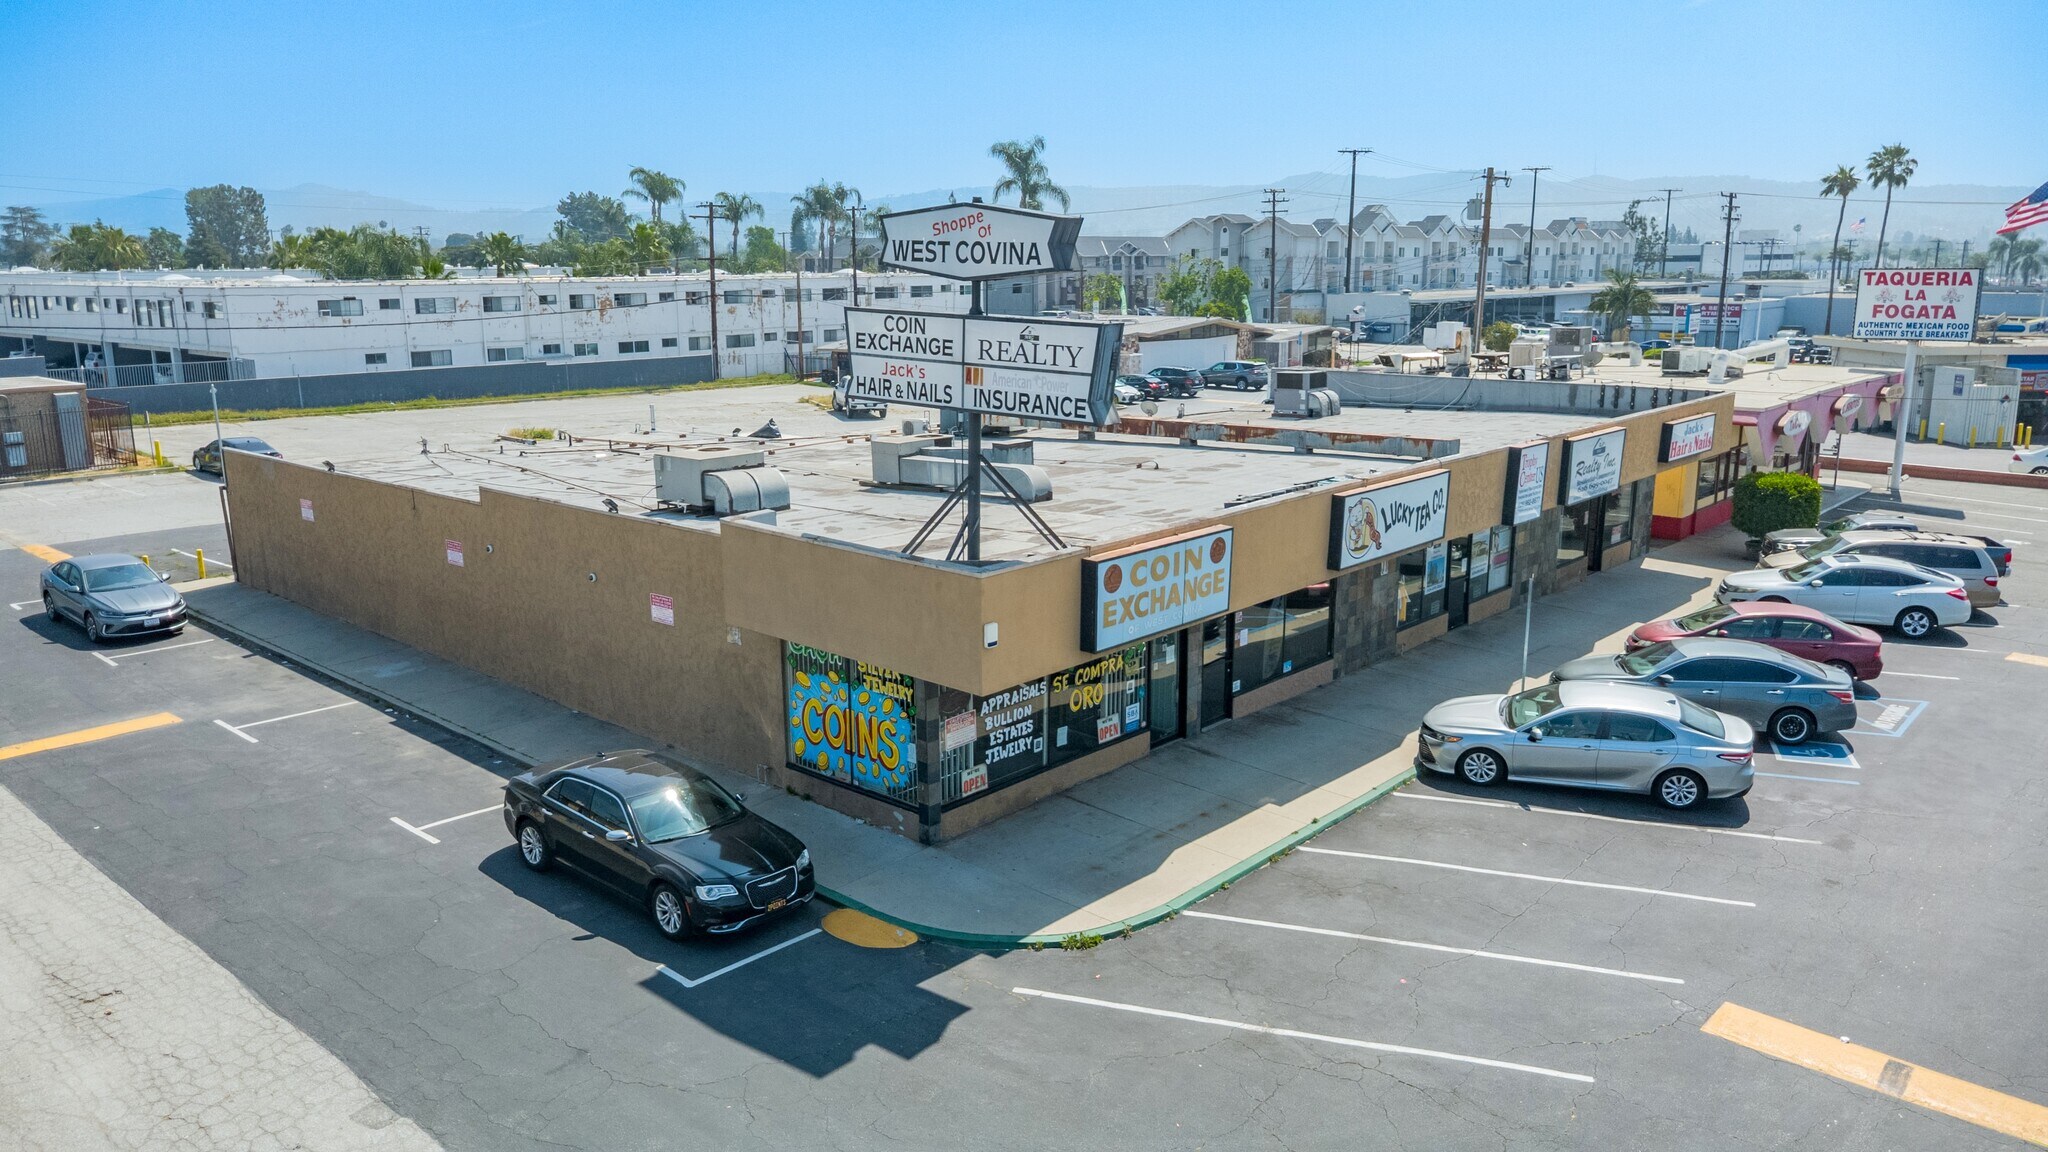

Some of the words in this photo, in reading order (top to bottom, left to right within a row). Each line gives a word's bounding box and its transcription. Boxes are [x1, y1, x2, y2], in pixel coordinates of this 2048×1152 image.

[932, 211, 984, 237] Shoppe
[978, 224, 992, 238] Of
[892, 239, 951, 264] WEST
[955, 241, 1042, 266] COVINA
[1864, 271, 1973, 287] TAQUERIA
[1905, 289, 1927, 301] LA
[884, 315, 926, 335] COIN
[1872, 304, 1957, 319] FOGATA
[1858, 321, 1903, 329] AUTHENTIC
[1906, 322, 1944, 330] MEXICAN
[1900, 330, 1923, 338] STYLE
[1925, 331, 1969, 339] BREAKFAST
[856, 332, 953, 357] EXCHANGE
[978, 339, 1084, 368] REALTY
[882, 362, 926, 379] Jack's
[992, 372, 1032, 390] American
[1041, 376, 1069, 393] Power
[856, 375, 892, 398] HAIR
[895, 384, 904, 399] &
[906, 381, 953, 404] NAILS
[974, 388, 1087, 419] INSURANCE
[1670, 438, 1688, 458] Hair
[1693, 432, 1712, 451] Nails
[1575, 458, 1601, 478] Realty
[1381, 504, 1415, 533] LUCKY
[1415, 505, 1431, 531] TEA
[1432, 487, 1445, 516] CO.
[1130, 546, 1203, 588] COIN
[1103, 568, 1225, 629] EXCHANGE
[1052, 674, 1070, 694] SE
[1074, 654, 1124, 686] COMPRA
[863, 675, 914, 703] JEWELRY
[980, 681, 1048, 717] APPRAISALS
[1069, 682, 1105, 713] ORO
[985, 704, 1032, 731] BULLION
[802, 697, 900, 770] COINS
[990, 719, 1033, 746] ESTATES
[1099, 722, 1119, 741] OPEN
[985, 736, 1033, 765] JEWELRY
[963, 773, 986, 794] OPEN
